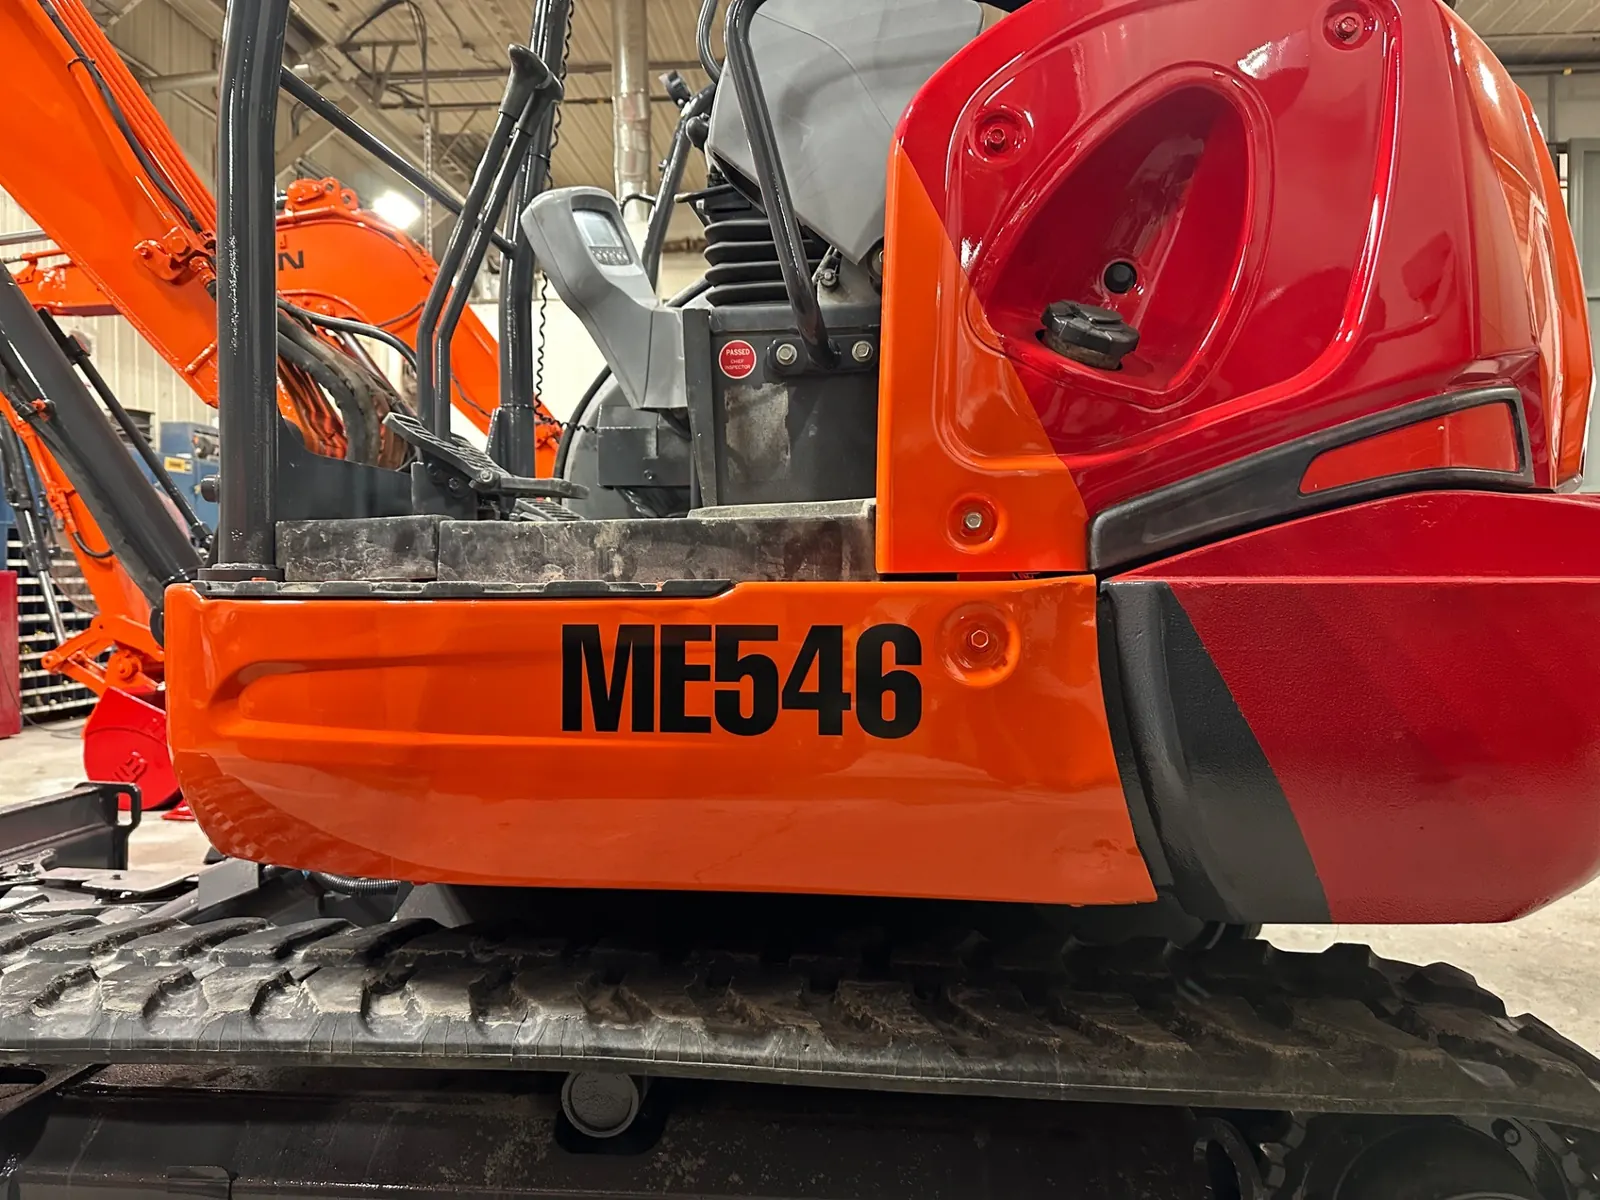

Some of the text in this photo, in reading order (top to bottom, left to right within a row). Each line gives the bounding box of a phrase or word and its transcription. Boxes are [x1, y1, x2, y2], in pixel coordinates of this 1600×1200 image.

[277, 250, 304, 271] N
[725, 348, 751, 356] PASSED
[562, 623, 922, 739] ME546
